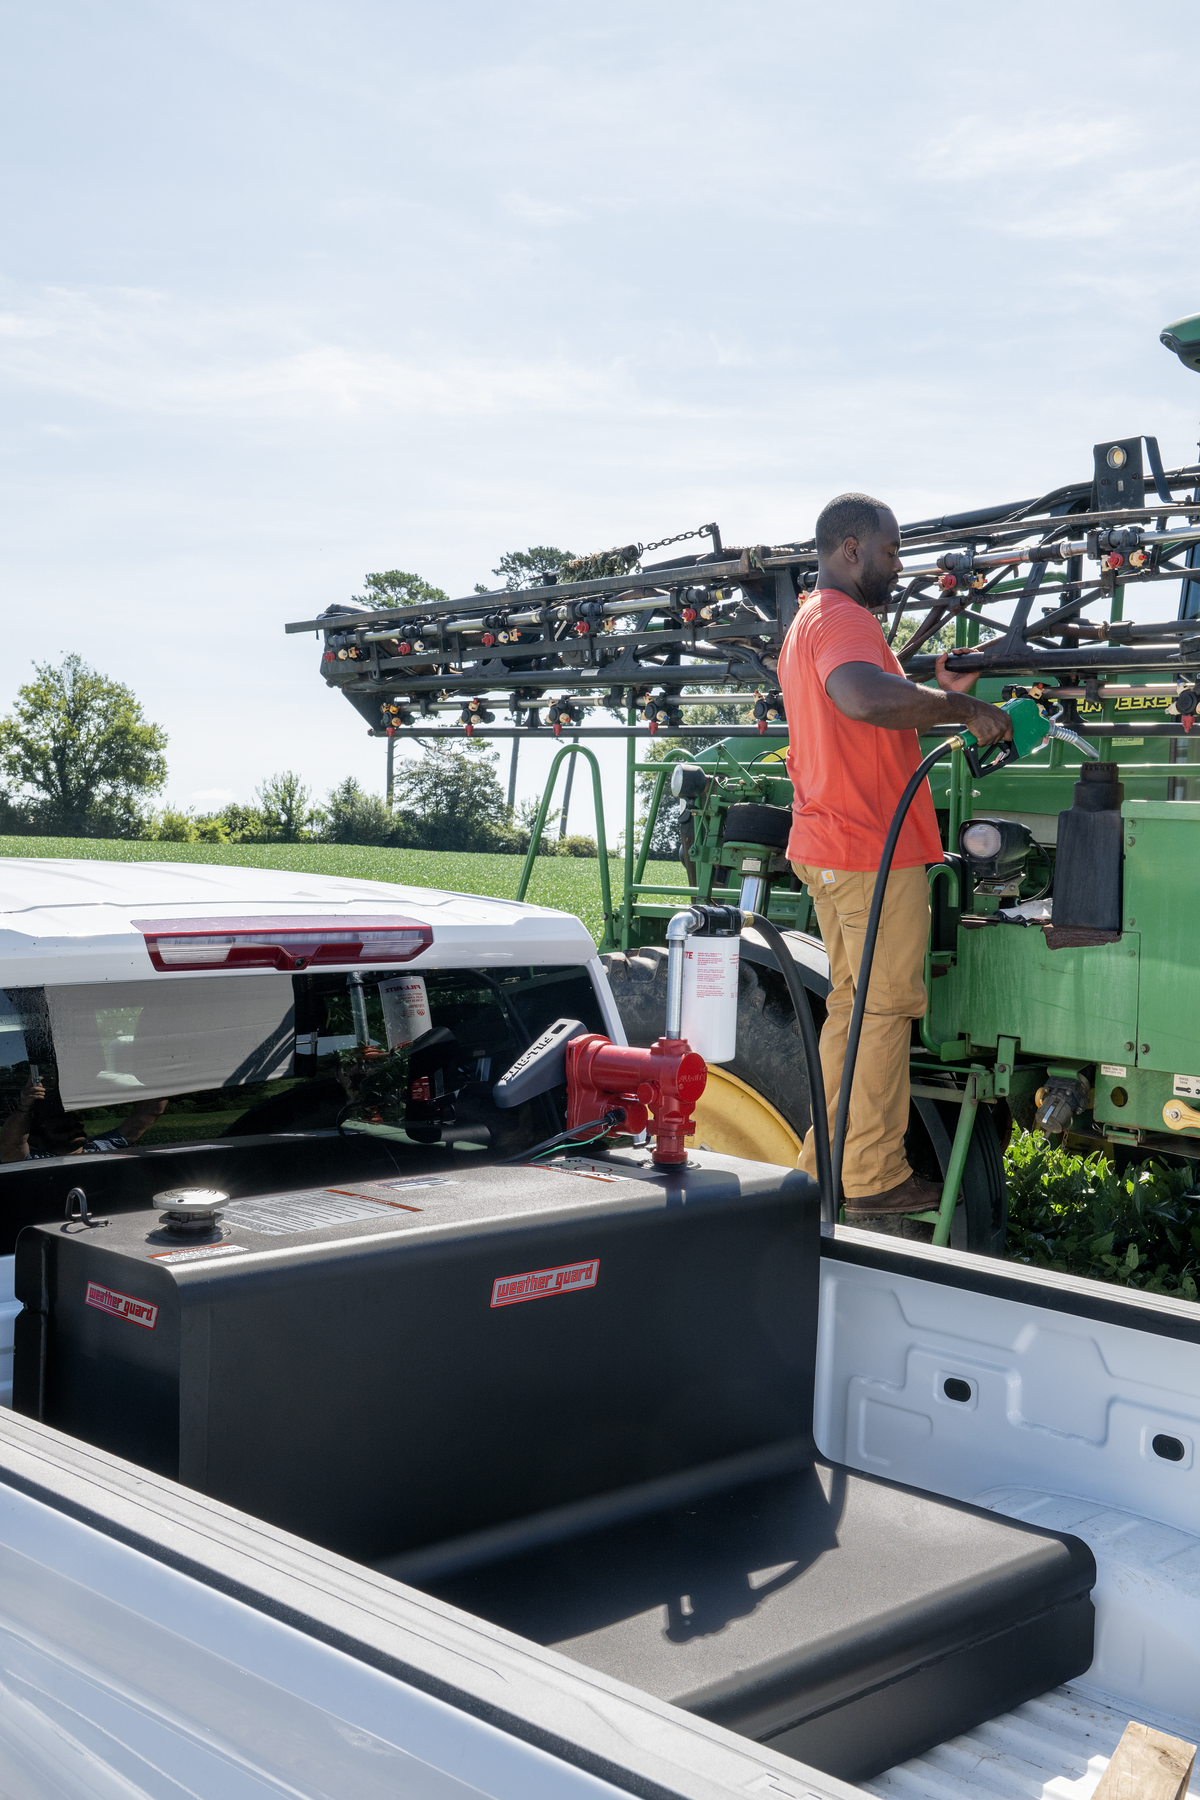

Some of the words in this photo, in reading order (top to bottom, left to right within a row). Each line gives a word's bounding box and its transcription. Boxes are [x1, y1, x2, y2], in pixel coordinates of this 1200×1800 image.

[1115, 697, 1171, 710] EERE
[496, 1273, 553, 1298] weather
[555, 1263, 594, 1290] guard
[88, 1286, 123, 1309] weather
[123, 1300, 154, 1321] guard
